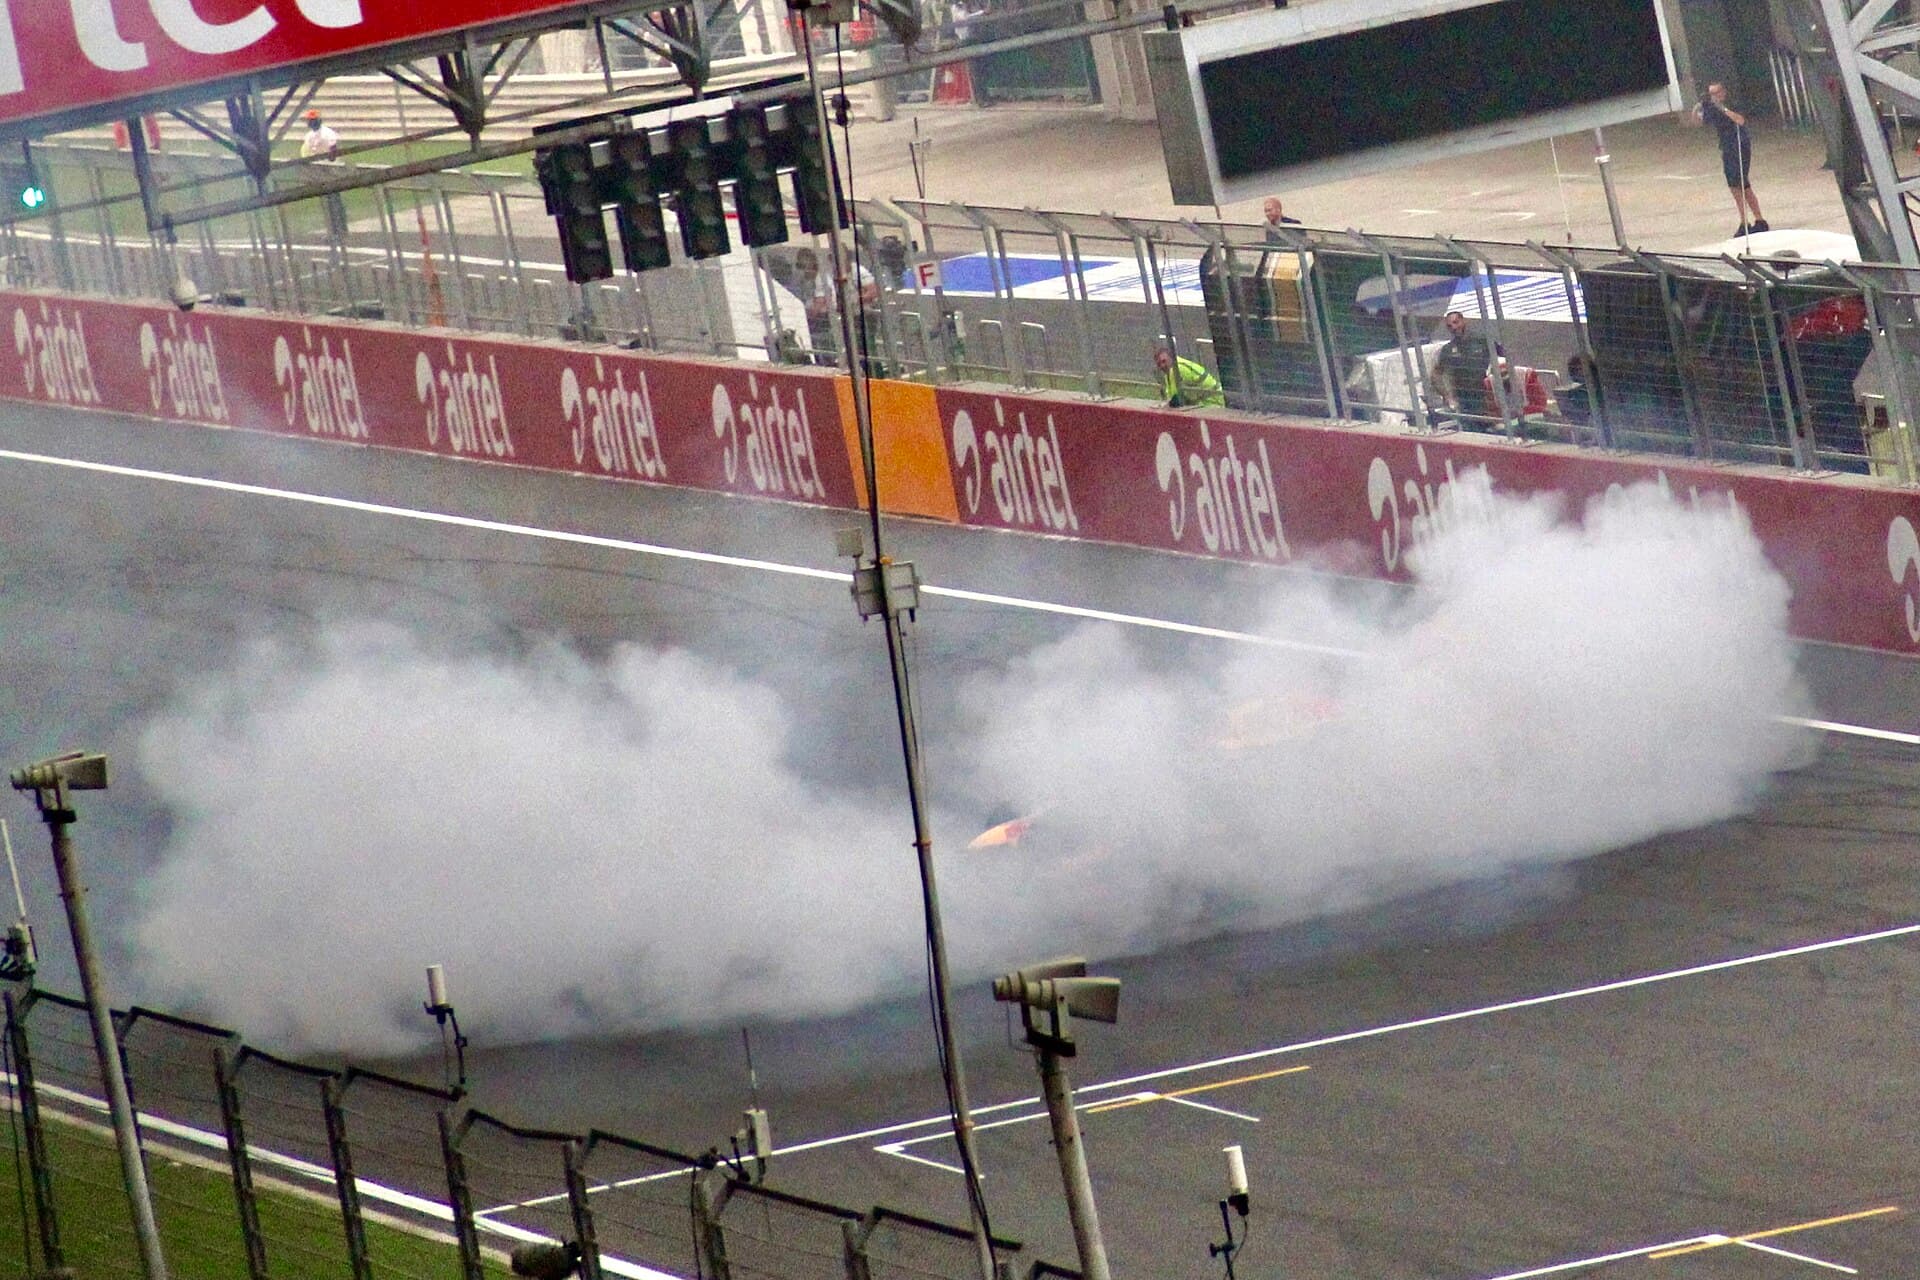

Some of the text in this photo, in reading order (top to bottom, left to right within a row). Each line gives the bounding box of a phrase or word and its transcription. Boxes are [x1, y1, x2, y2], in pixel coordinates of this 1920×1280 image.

[919, 263, 934, 286] F
[34, 299, 100, 402] airtel
[163, 312, 230, 421] airtel
[298, 325, 369, 438] airtel
[439, 342, 515, 457] airtel
[586, 355, 667, 478] airtel
[740, 373, 826, 498] airtel
[985, 398, 1079, 531] airtel
[1190, 419, 1291, 560] airtel
